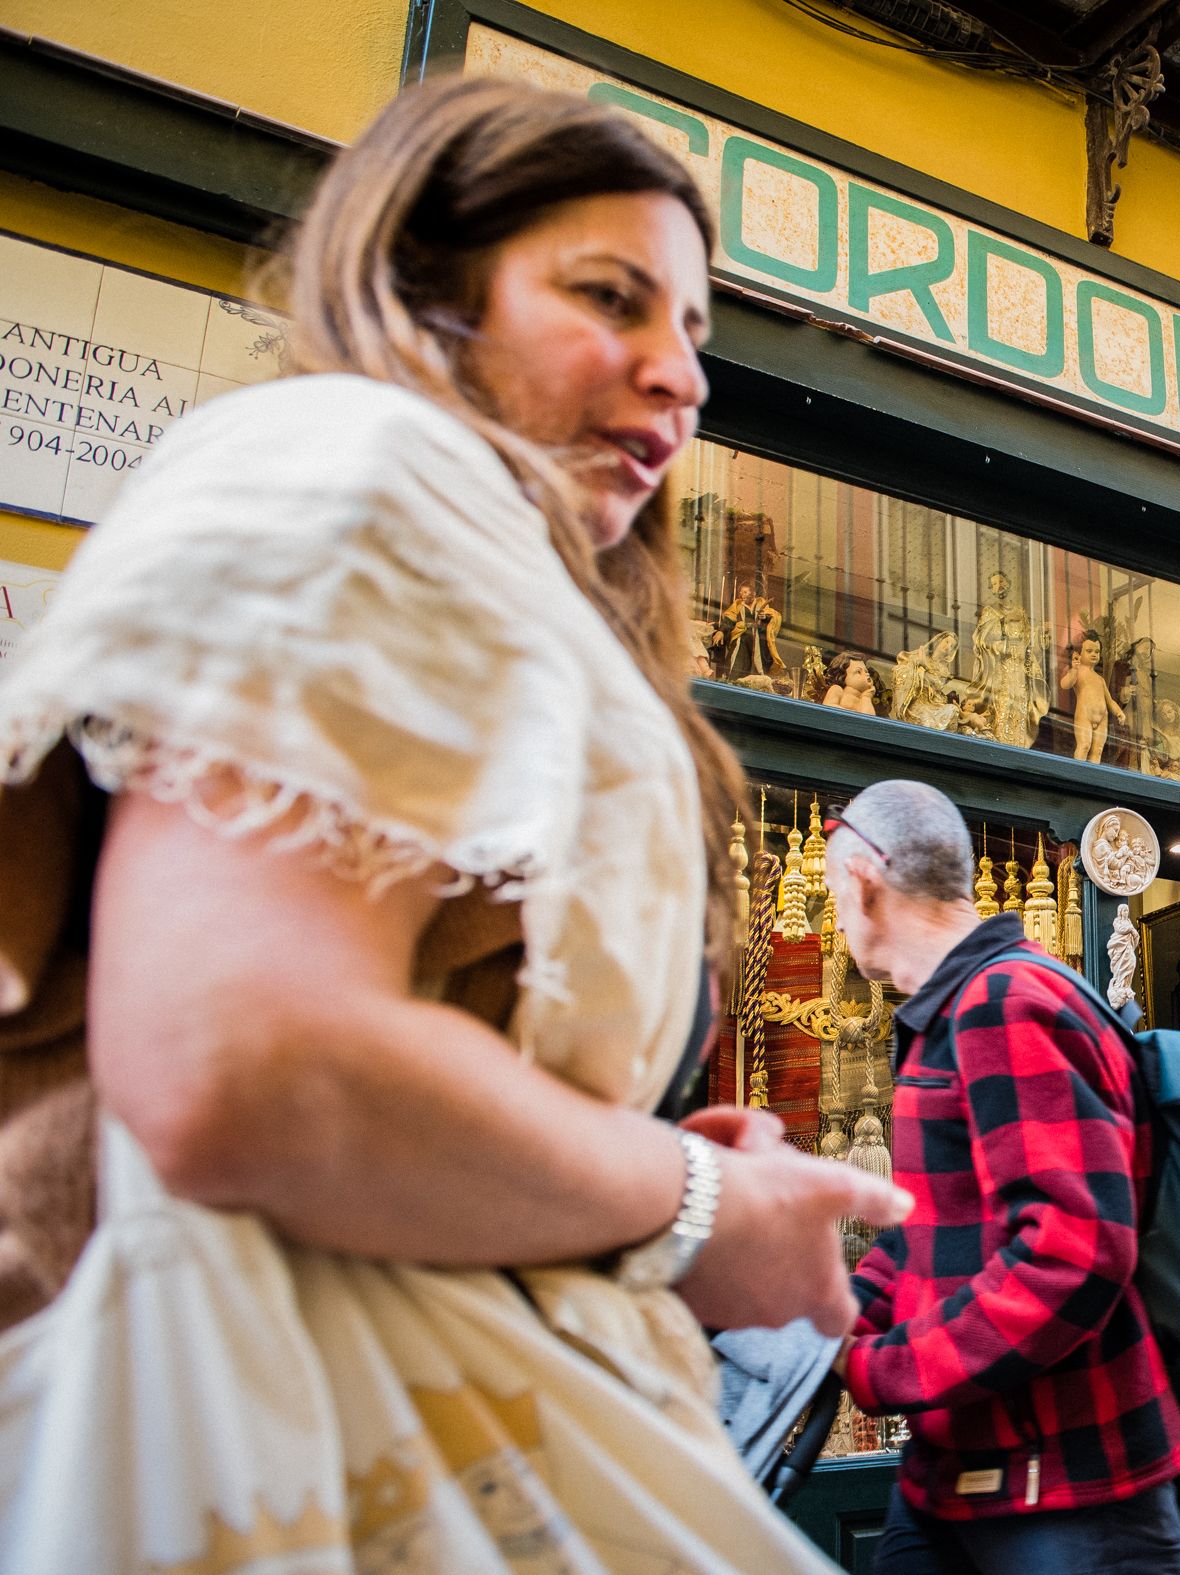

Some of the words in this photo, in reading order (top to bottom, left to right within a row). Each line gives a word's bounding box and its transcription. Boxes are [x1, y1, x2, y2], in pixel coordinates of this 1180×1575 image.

[2, 322, 164, 381] ANTIGUA
[0, 353, 141, 408] ONERIA
[0, 422, 143, 471] 904-2004
